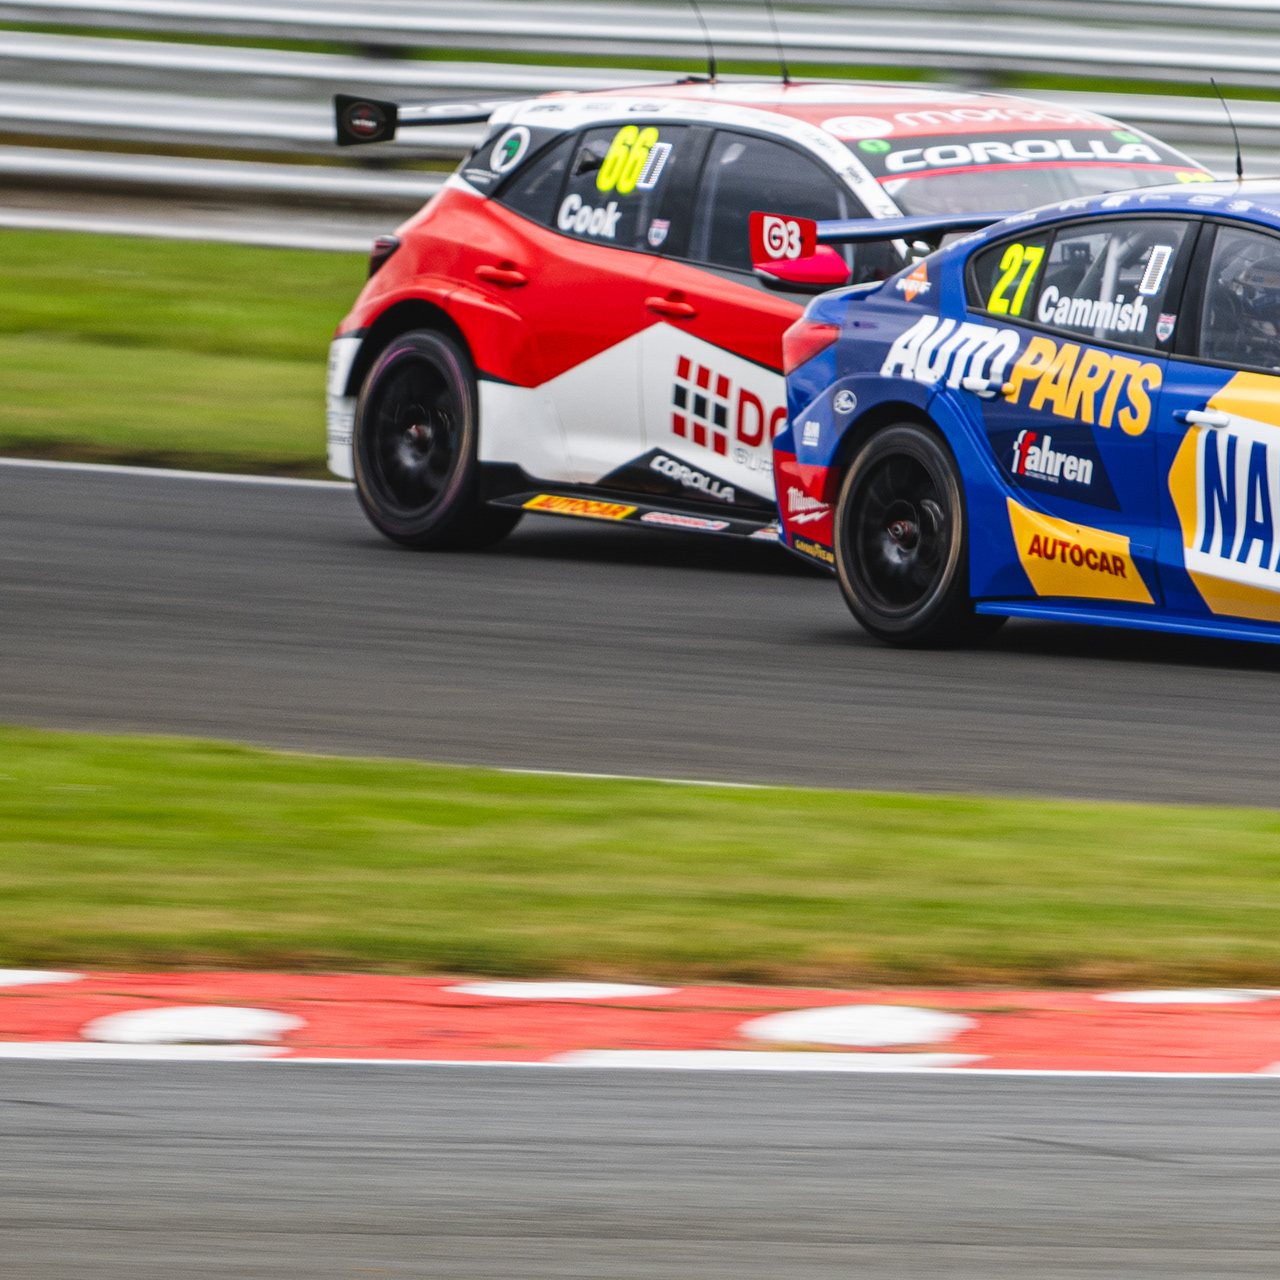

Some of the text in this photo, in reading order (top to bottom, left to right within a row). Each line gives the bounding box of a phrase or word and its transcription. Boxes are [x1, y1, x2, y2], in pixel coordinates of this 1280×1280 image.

[596, 125, 659, 194] 66
[885, 139, 1162, 173] COROLLA
[557, 194, 622, 238] Cook
[987, 243, 1045, 316] 27
[1037, 285, 1150, 333] Cammish
[880, 314, 1162, 436] AUTO PARTS
[650, 455, 735, 504] COROLLA
[1012, 429, 1094, 485] fahren
[536, 495, 628, 519] AUTOCAR
[1028, 534, 1127, 579] AUTOCAR
